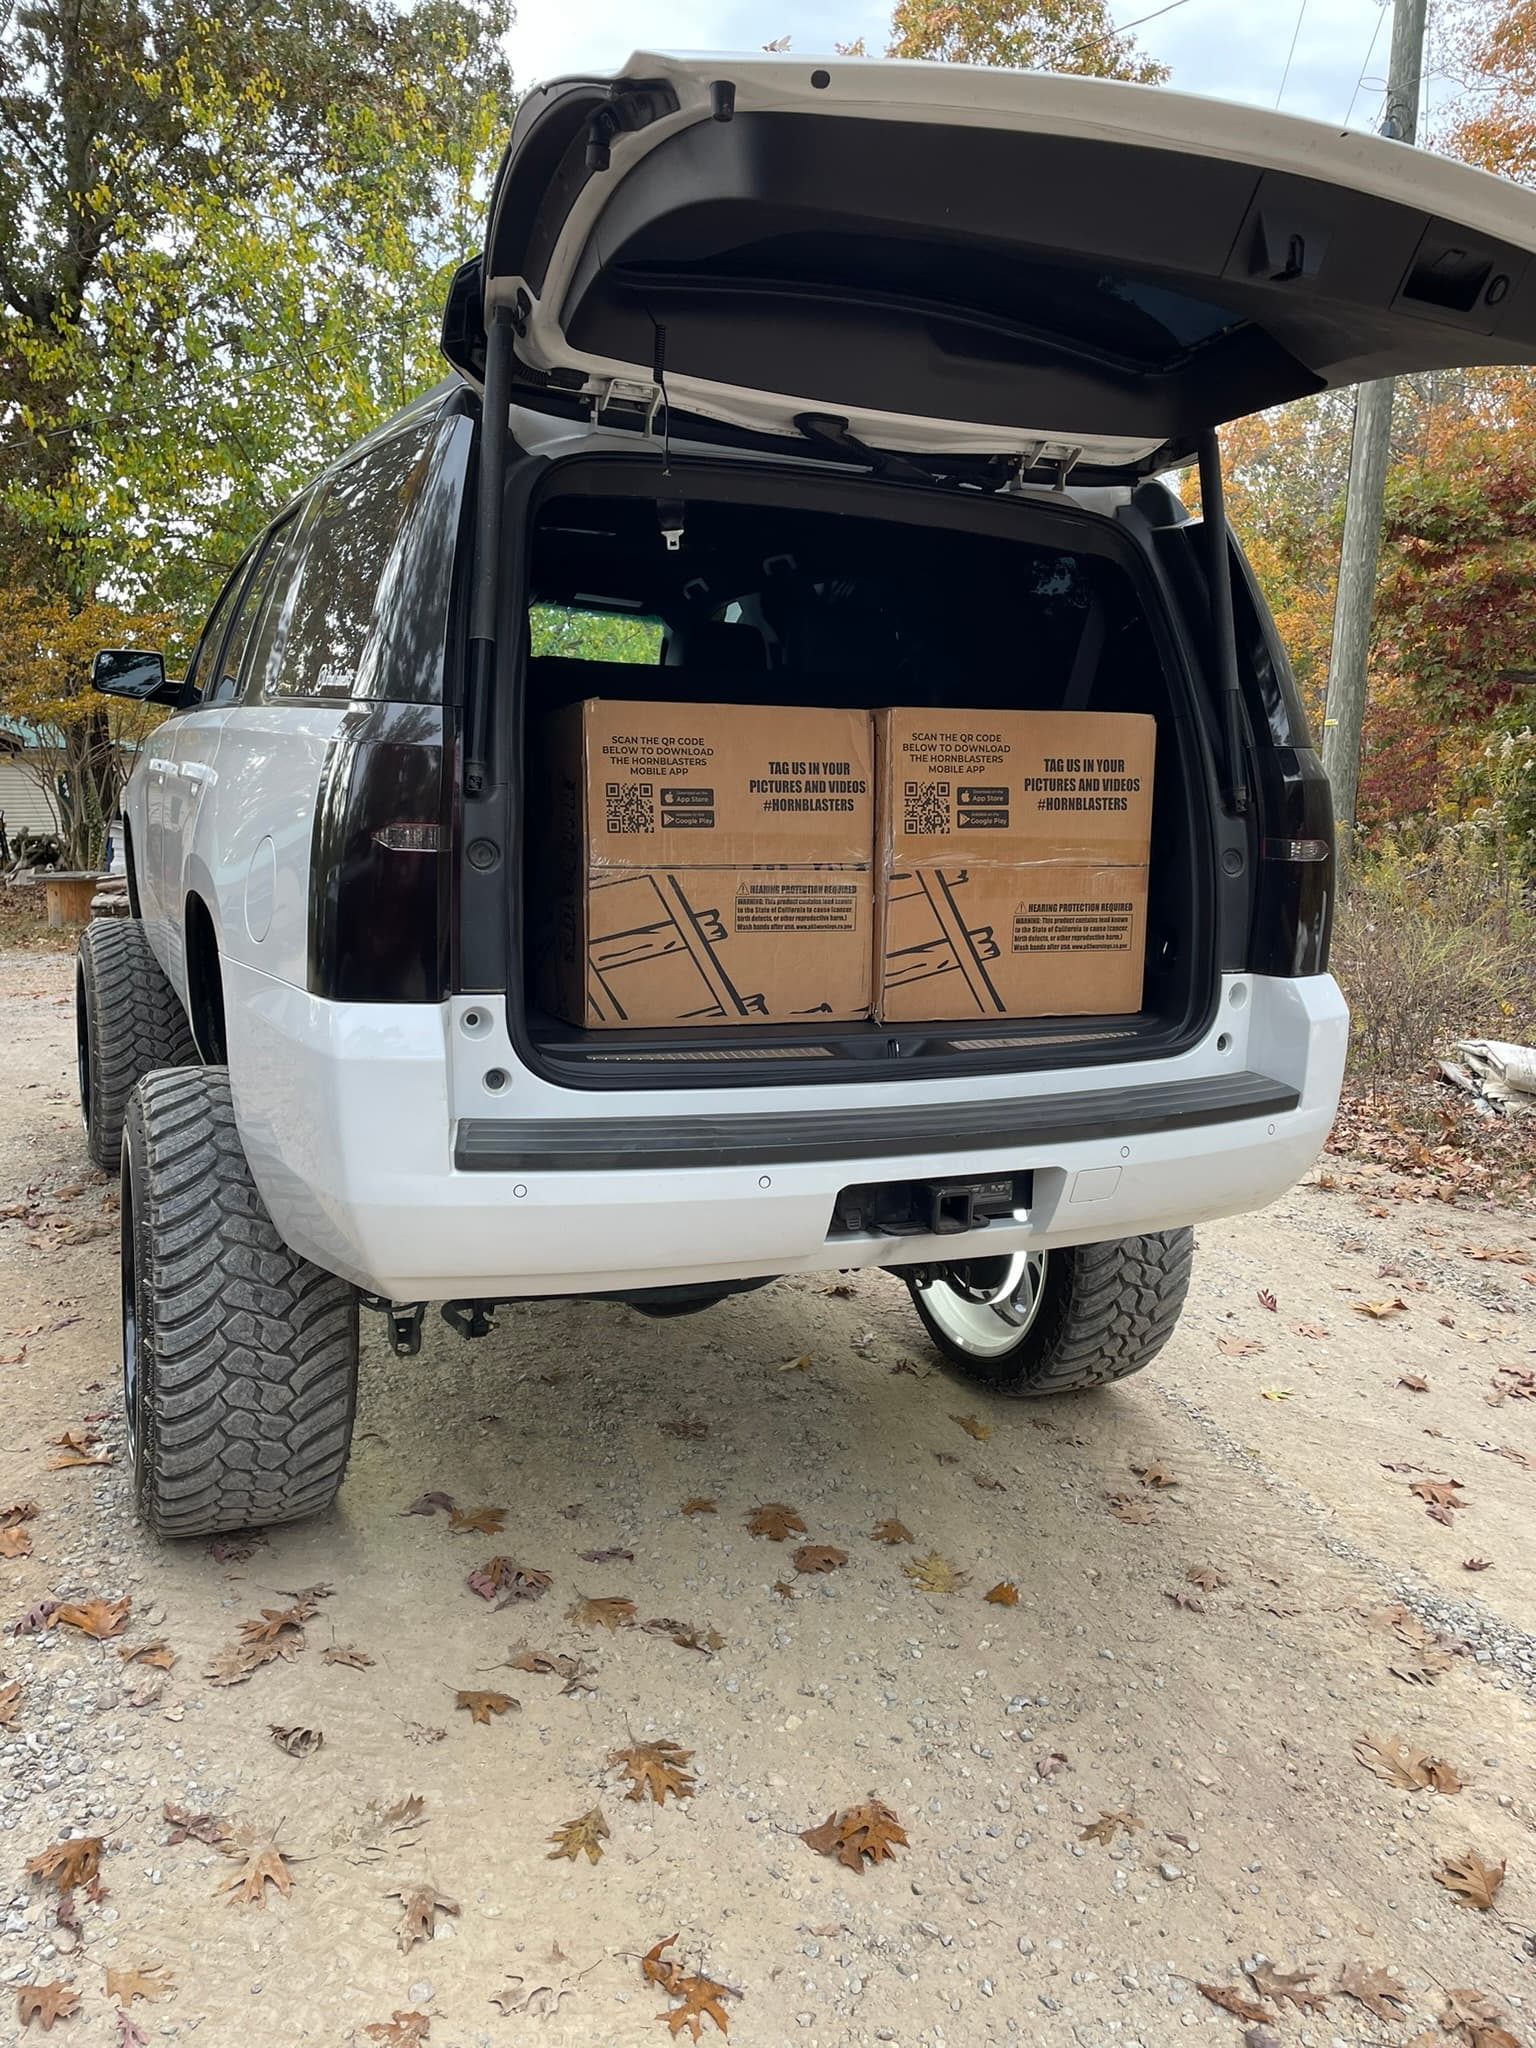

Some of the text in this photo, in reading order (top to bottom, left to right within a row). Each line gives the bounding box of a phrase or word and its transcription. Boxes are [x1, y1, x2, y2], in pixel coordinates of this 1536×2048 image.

[612, 736, 704, 746] SCAN THE QR CODE
[912, 733, 1002, 742] SCAN THE QR CODE
[602, 746, 714, 756] BELOW TO DOWNLOAD
[903, 744, 1010, 753] BELOW TO DOWNLOAD
[610, 756, 707, 766] THE HORNBLASTERS
[910, 754, 1004, 764] THE HORNBLASTERS
[768, 762, 850, 775] TAG US IN YOUR
[928, 766, 964, 774] MOBILE
[1044, 759, 1124, 772] TAG US IN YOUR
[630, 768, 666, 776] MOBILE
[750, 780, 866, 794] PICTURES AND VIDEOS
[1024, 778, 1140, 792] PICTURES AND VIDEOS
[763, 799, 854, 812] #HORNBLASTERS
[1038, 798, 1128, 810] #HORNBLASTERS
[699, 817, 712, 825] Play
[970, 817, 1006, 826] Google Play
[750, 885, 856, 894] HEARING PROTECTION REQUIRED
[1028, 903, 1132, 912] HEARING PROTECTION REQUIRED
